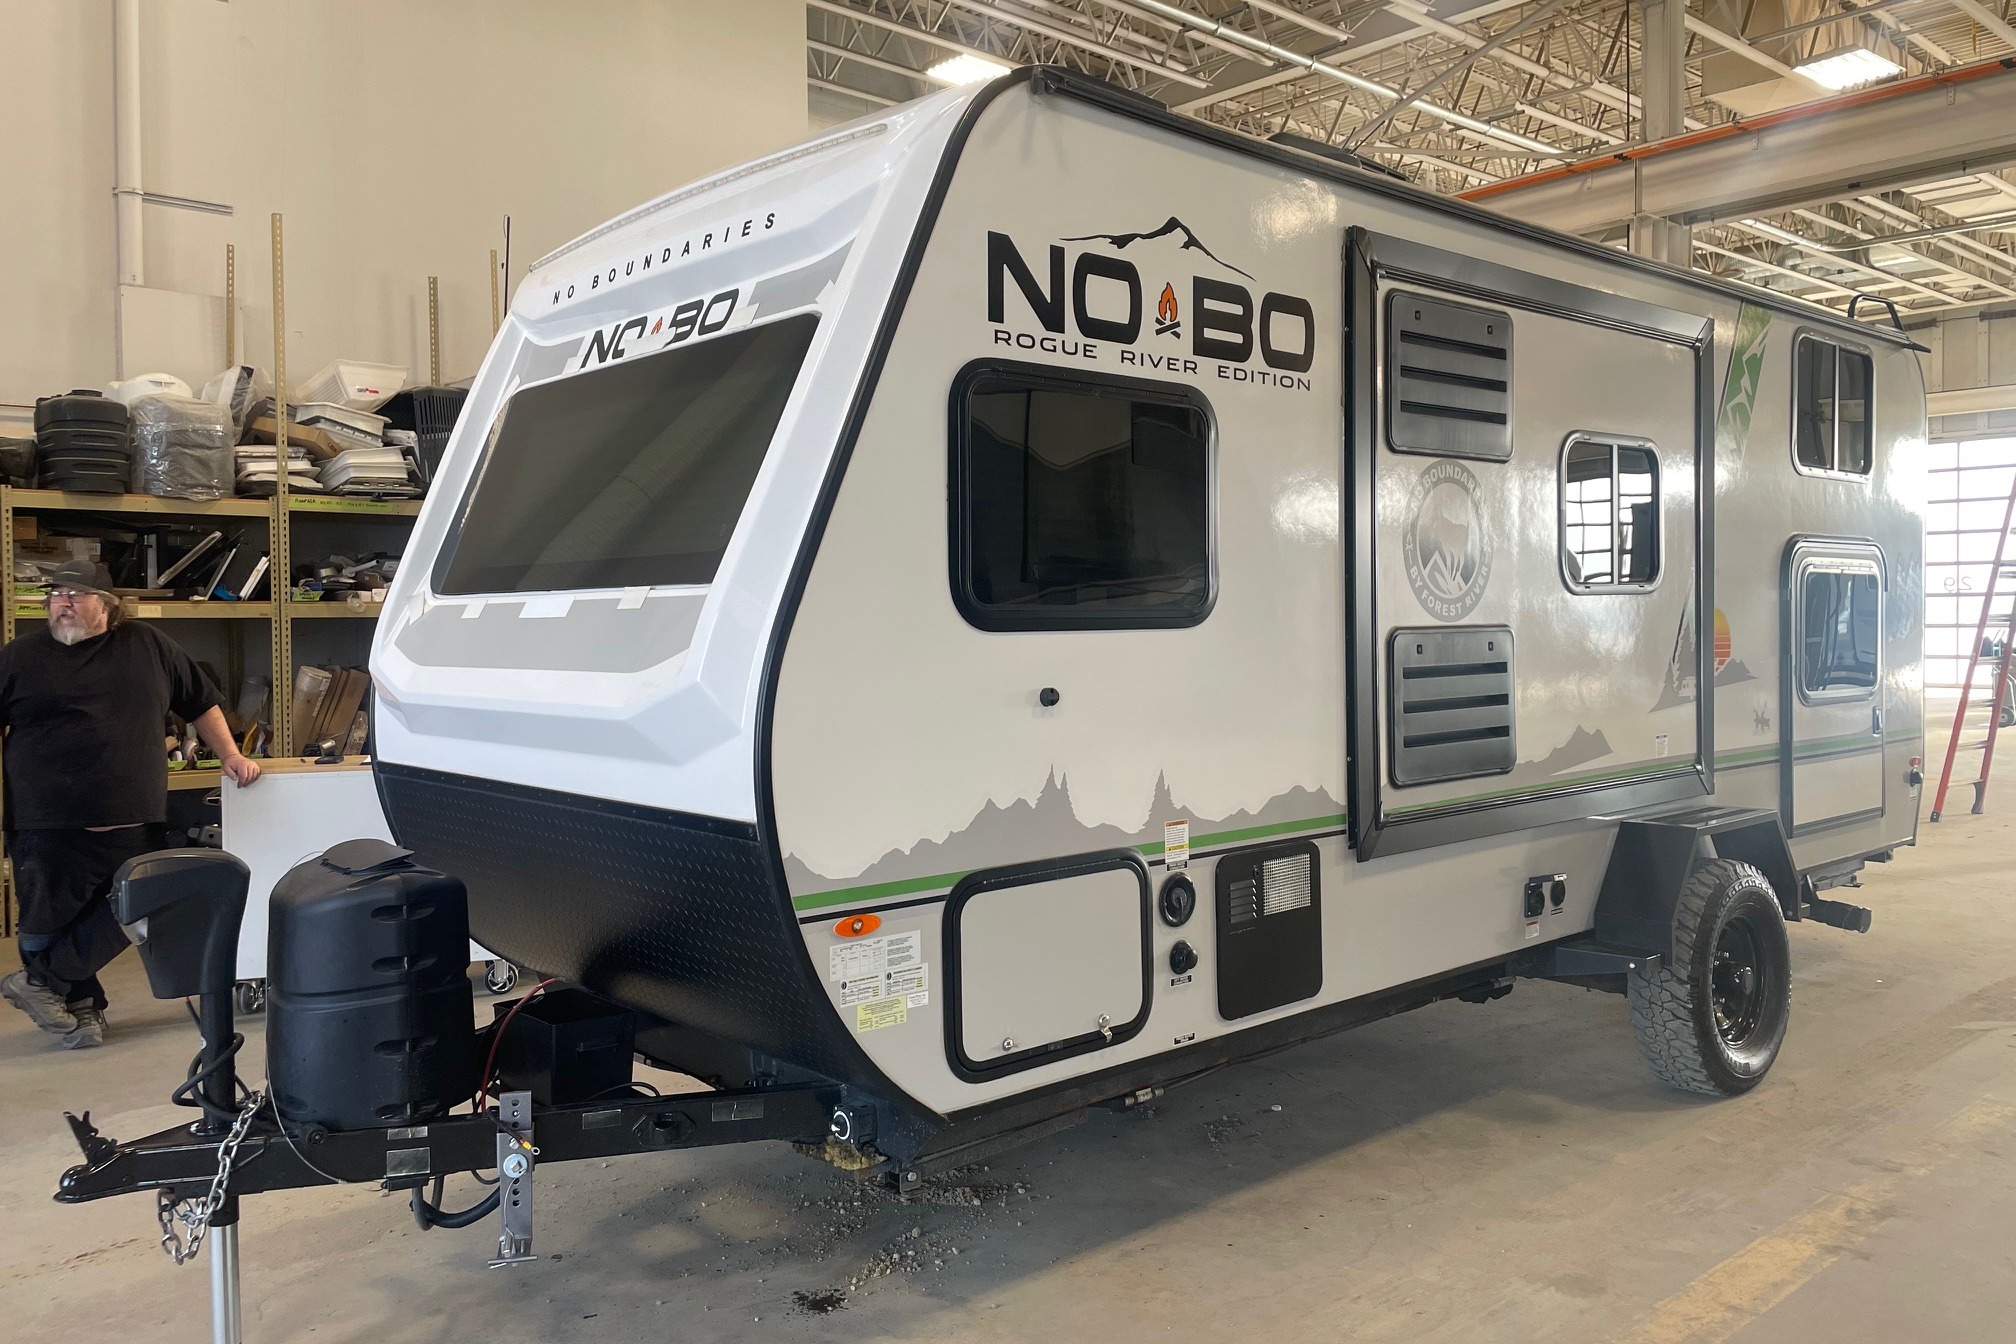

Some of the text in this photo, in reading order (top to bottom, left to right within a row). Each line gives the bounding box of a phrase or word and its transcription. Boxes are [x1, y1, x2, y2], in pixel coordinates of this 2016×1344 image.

[552, 212, 776, 305] NO BOUNDARIES
[663, 288, 740, 349] BO
[987, 230, 1315, 373] NO BO
[994, 329, 1312, 392] ROGUE RIVER EDITION
[1410, 565, 1489, 616] BY FOREST RIVER
